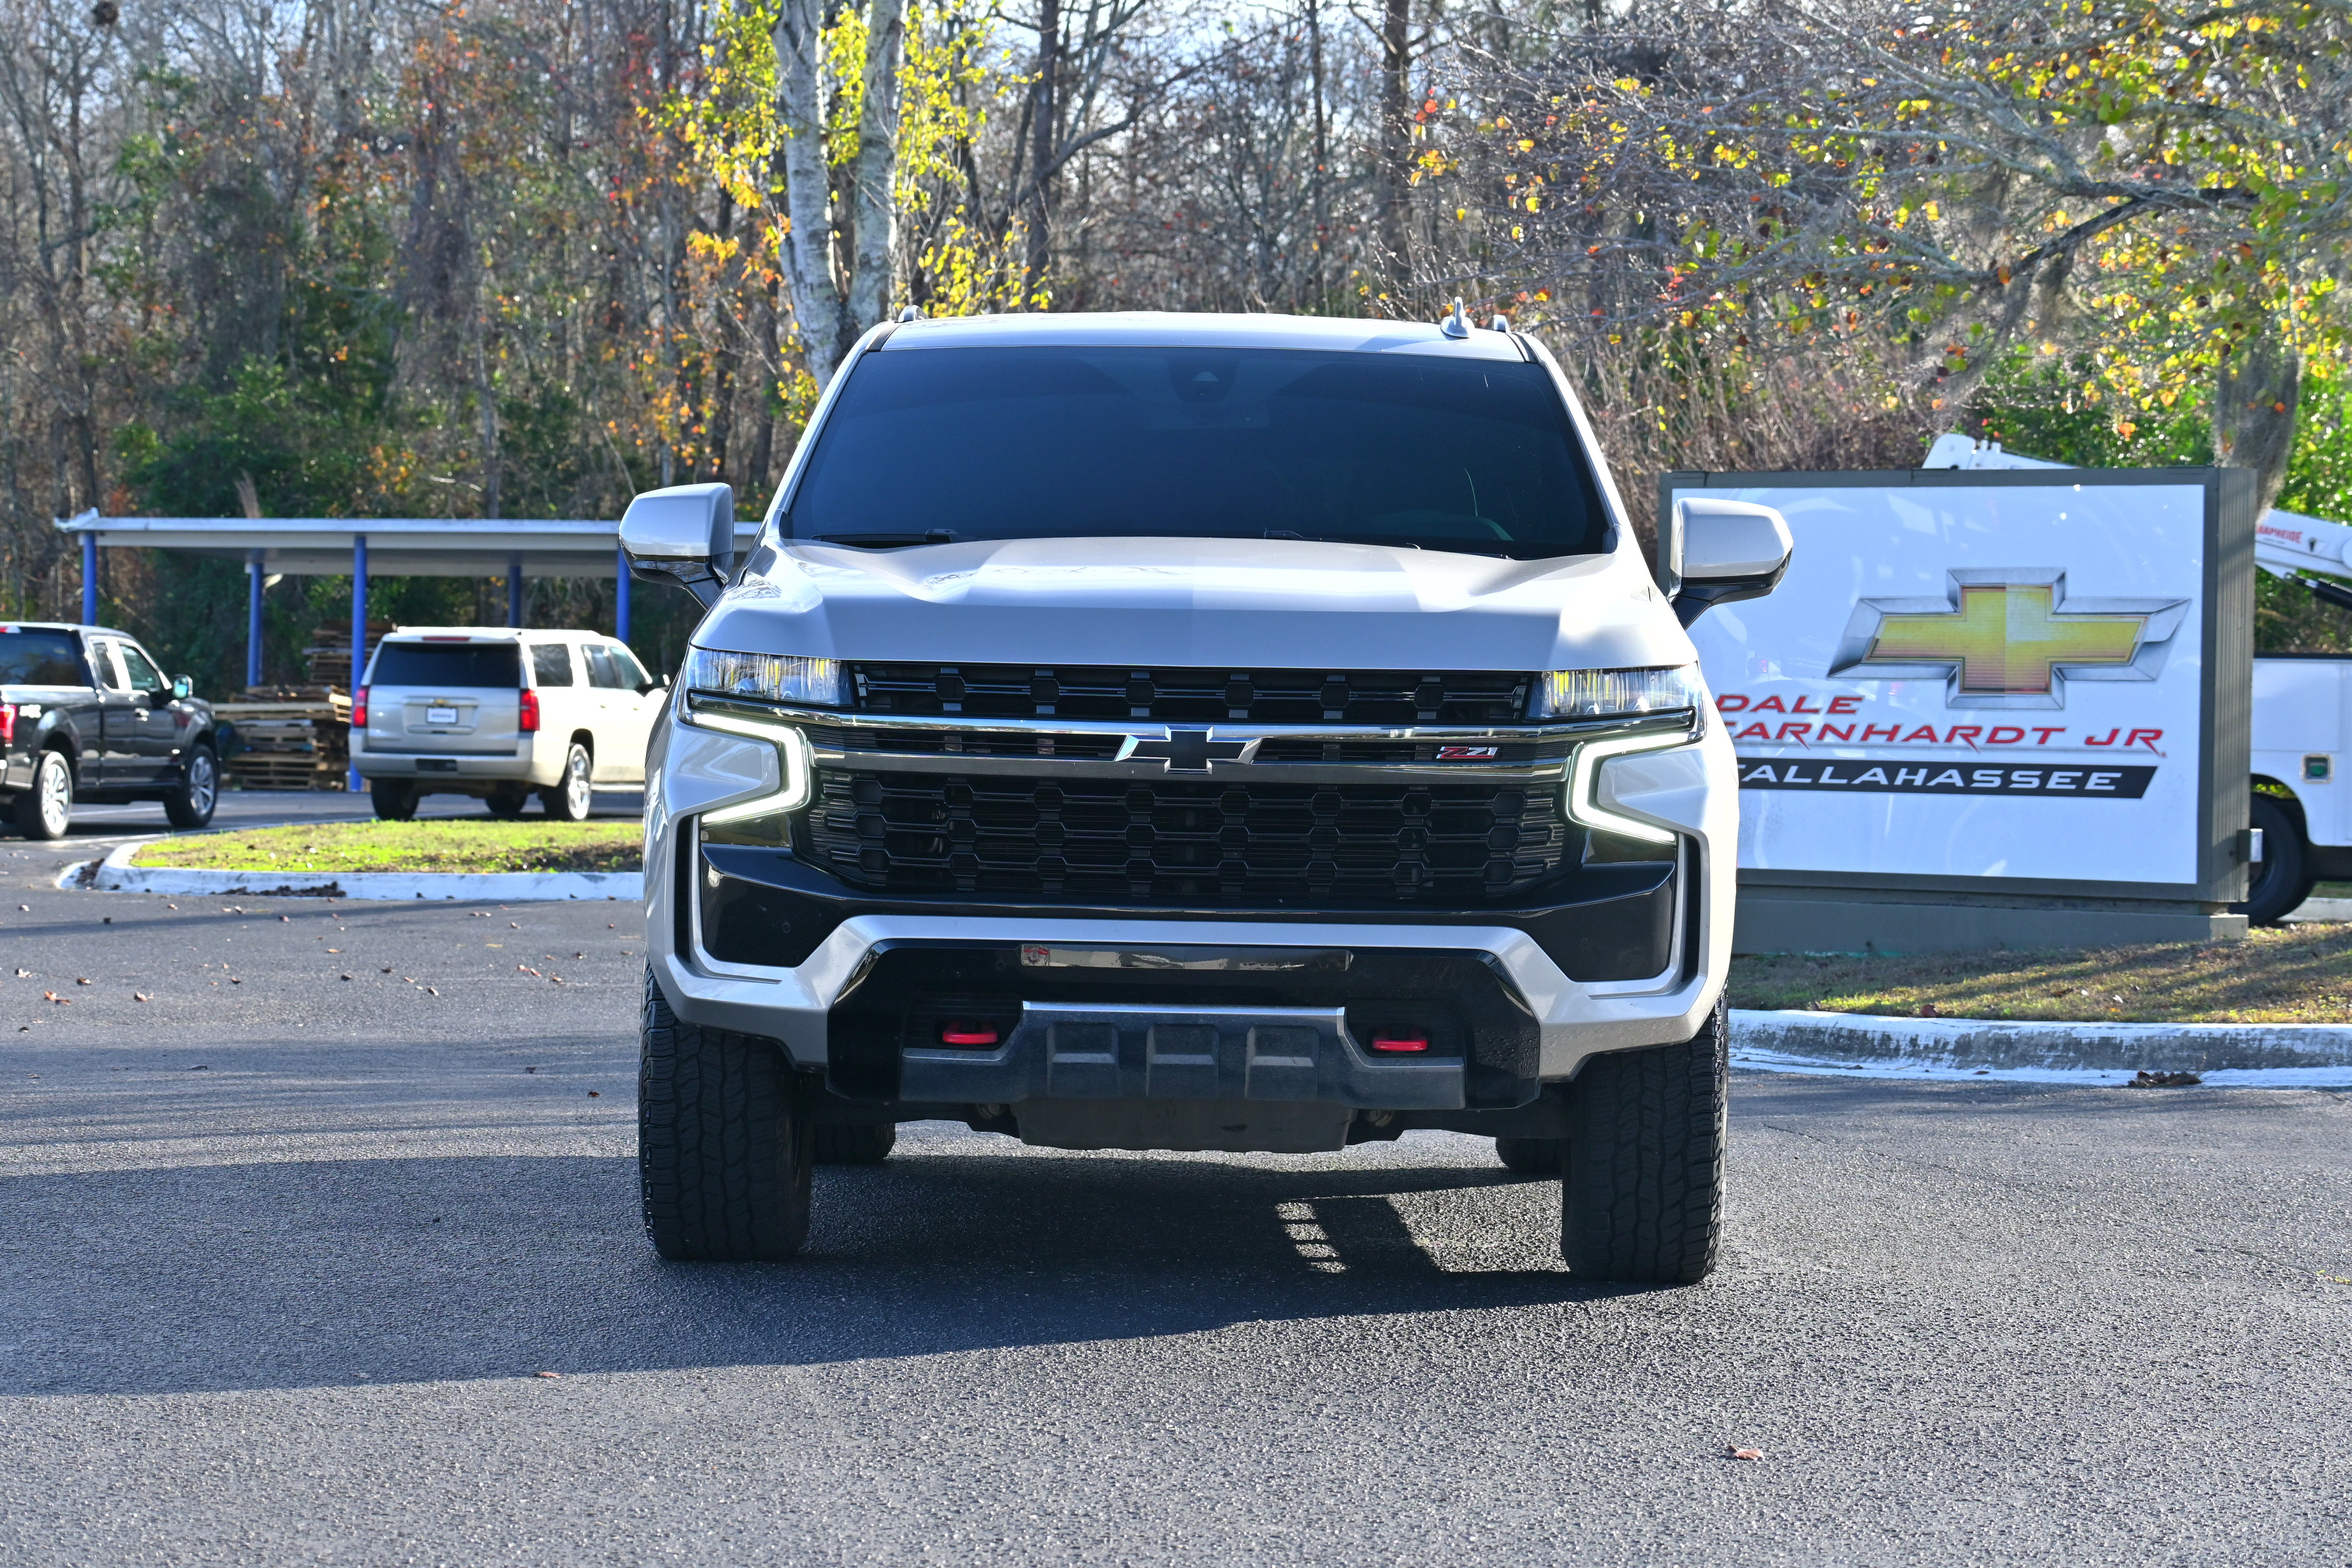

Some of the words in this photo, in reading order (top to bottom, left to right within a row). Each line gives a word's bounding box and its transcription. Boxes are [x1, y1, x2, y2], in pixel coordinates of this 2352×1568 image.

[1715, 694, 1865, 714] DALE
[1724, 721, 2066, 754] ARNHARDT
[2084, 727, 2164, 756] JR
[1436, 746, 1498, 759] Z71
[1737, 764, 2123, 790] ALLAHASSEE
